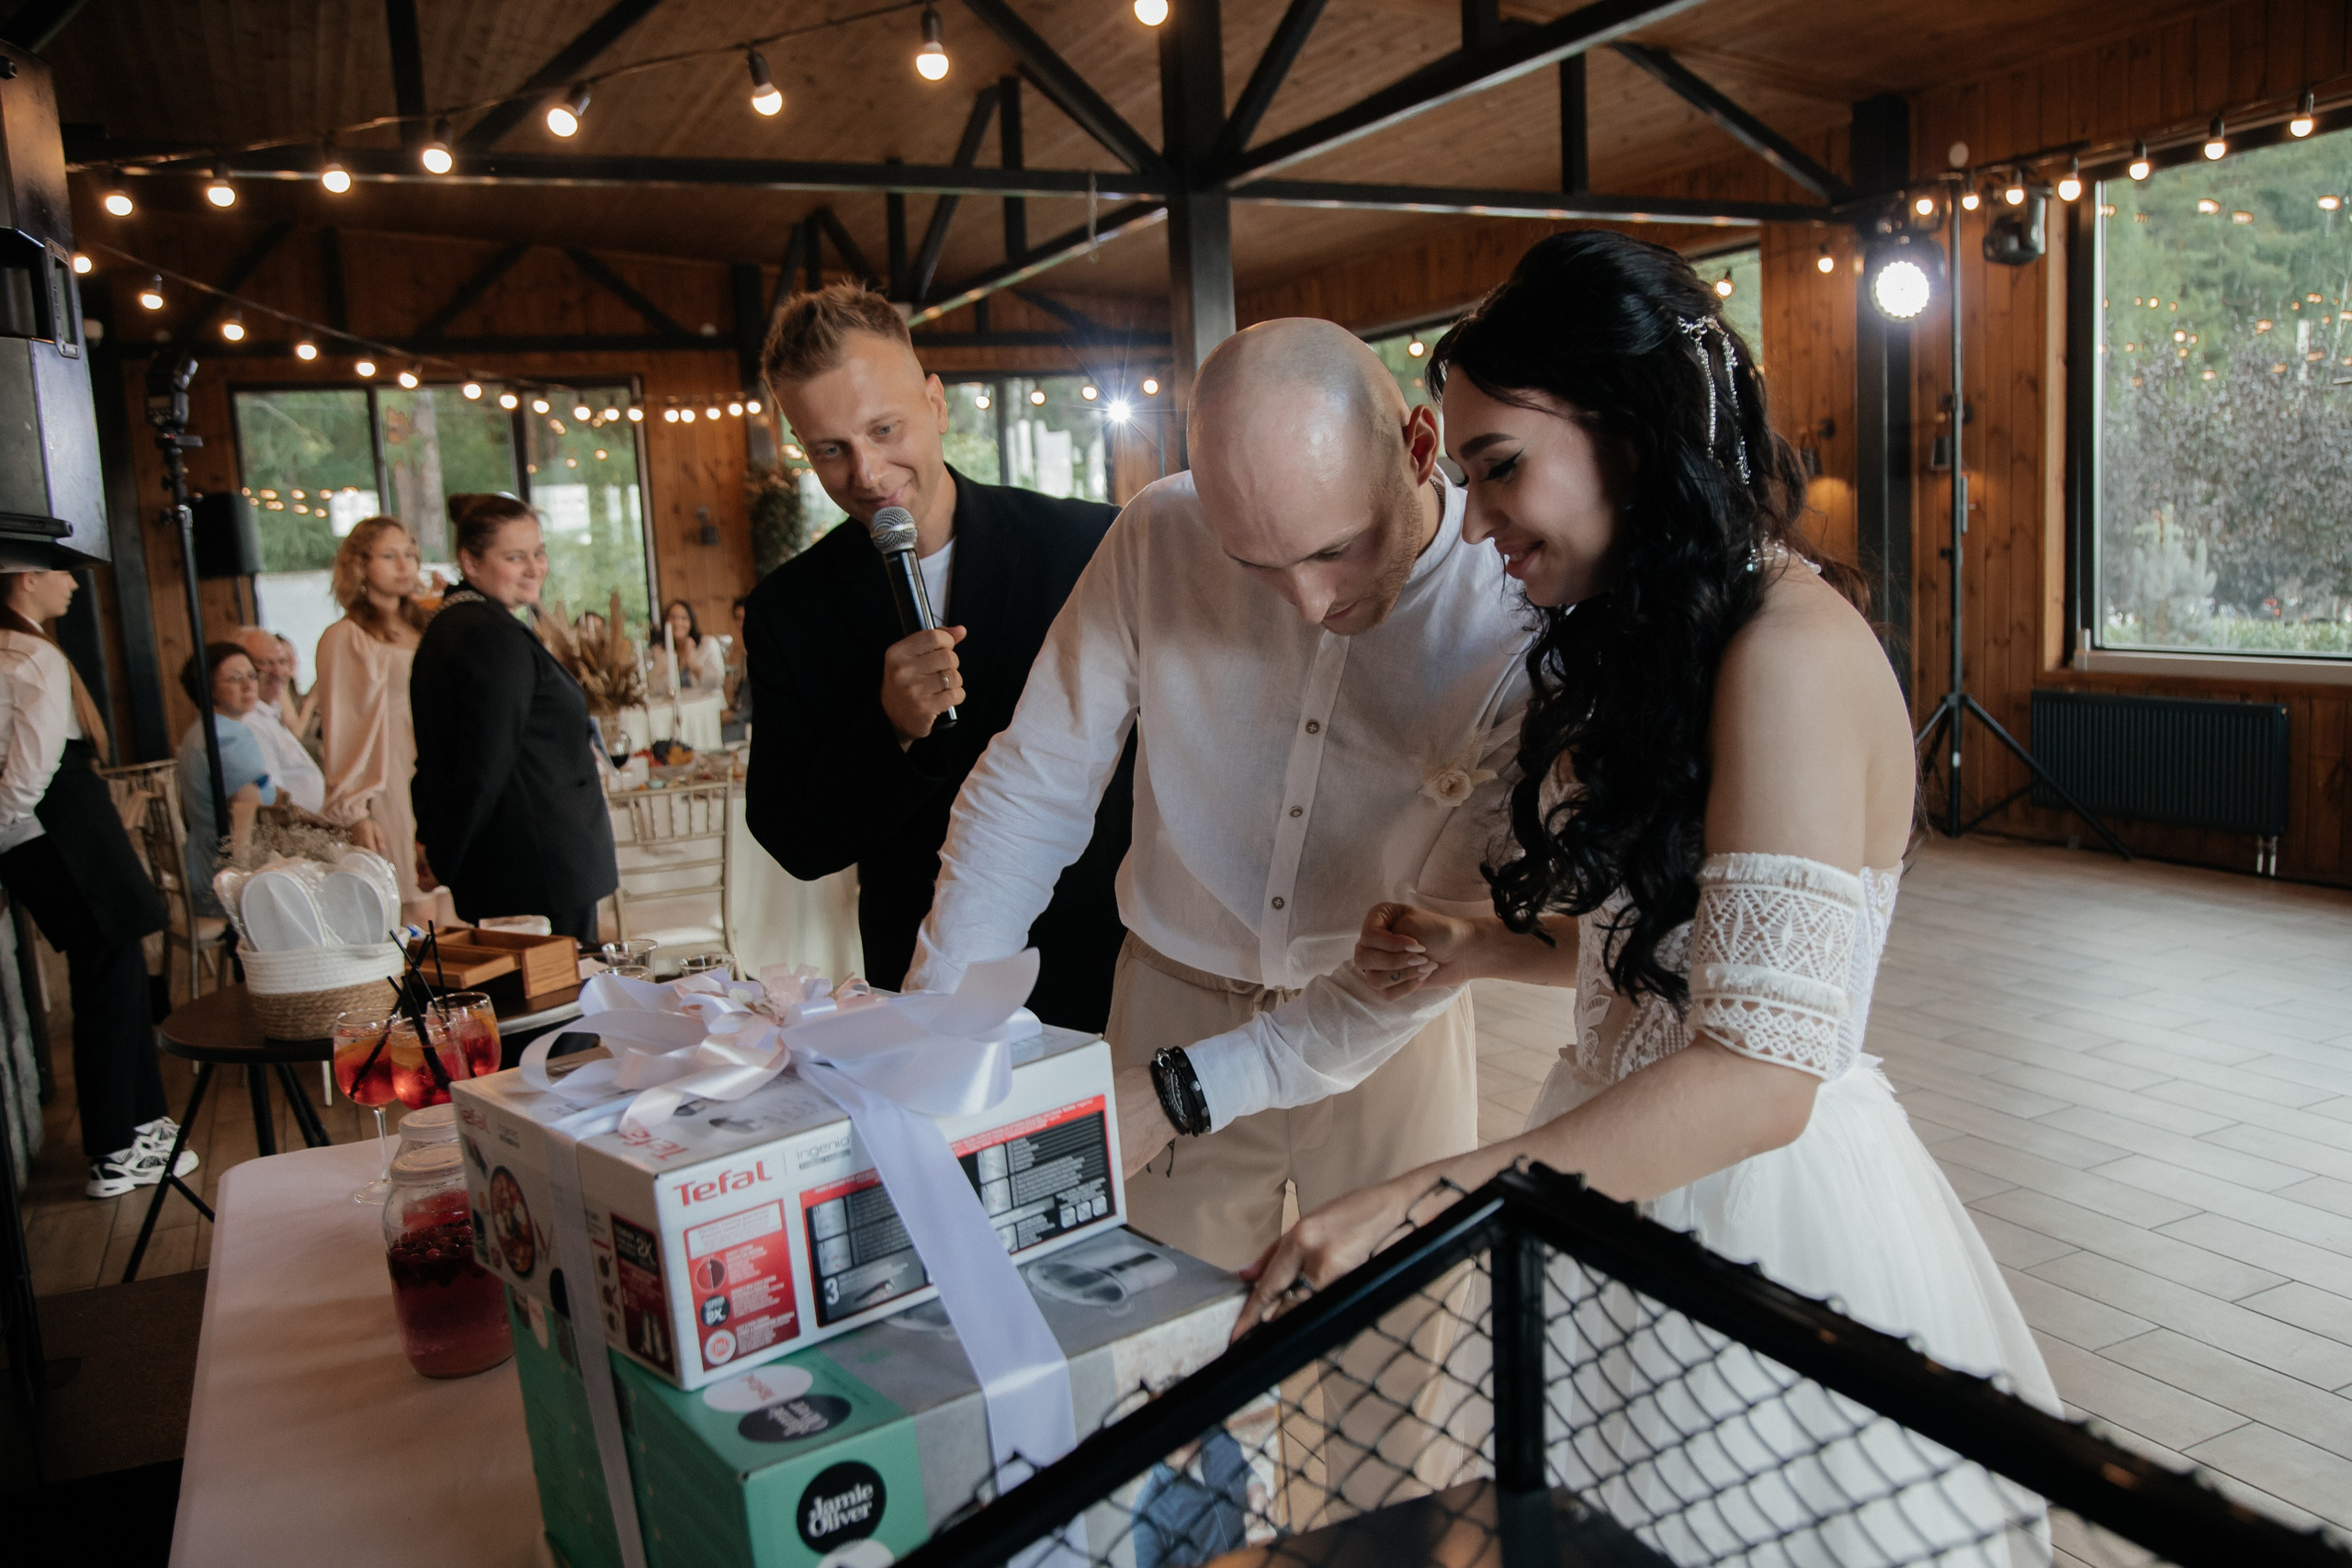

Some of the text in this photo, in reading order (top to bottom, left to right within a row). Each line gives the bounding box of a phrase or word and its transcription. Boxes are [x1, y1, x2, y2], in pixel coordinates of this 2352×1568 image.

[797, 1136, 850, 1160] ingenio
[673, 1160, 773, 1207] Tefal
[825, 1277, 840, 1305] 3
[808, 1483, 874, 1518] Jamie
[808, 1501, 872, 1538] Oliver
